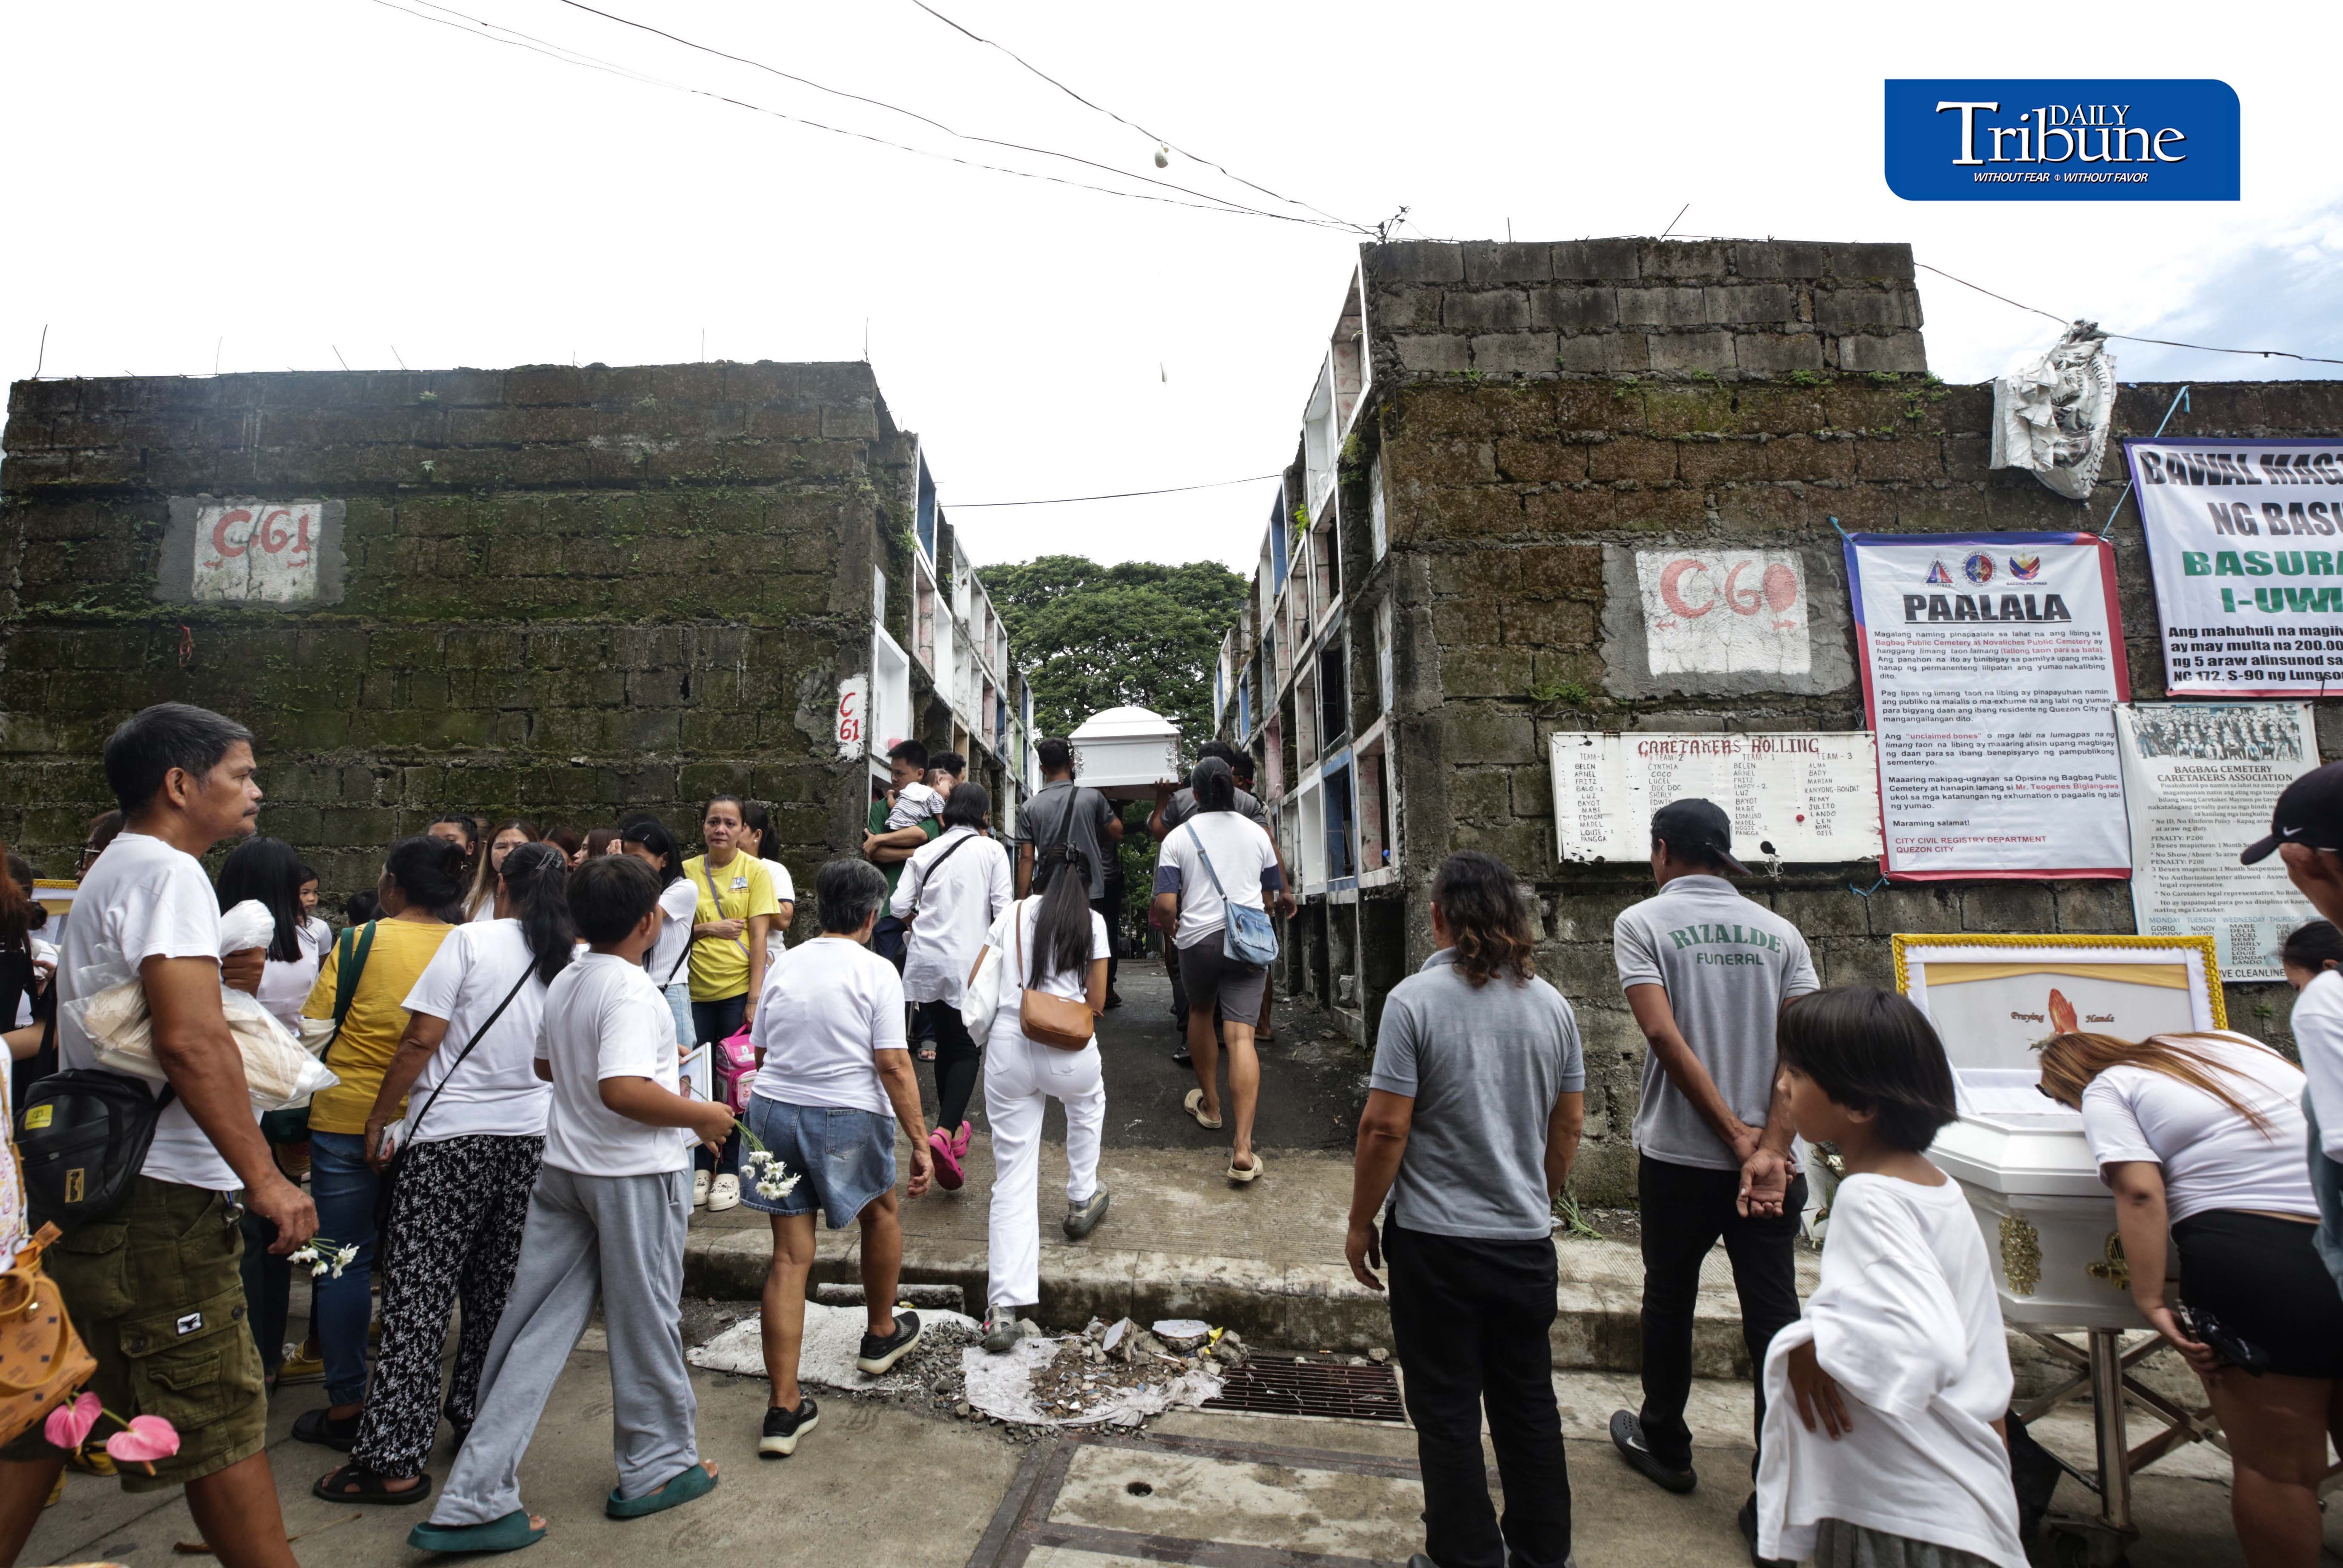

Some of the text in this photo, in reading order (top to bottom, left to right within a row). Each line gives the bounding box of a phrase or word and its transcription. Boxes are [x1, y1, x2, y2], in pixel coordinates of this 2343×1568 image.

[2140, 451, 2262, 486] BAWAL
[2207, 502, 2259, 536] NG
[2182, 551, 2343, 576] BASUR
[1903, 594, 2072, 620] PAALALA
[2169, 627, 2198, 638] Ang
[2202, 626, 2274, 636] mahuhuli
[2277, 627, 2295, 636] na
[2171, 643, 2187, 652] ay
[2191, 643, 2223, 652] may
[2227, 641, 2270, 651] multa
[2274, 642, 2291, 651] na
[2173, 658, 2190, 667] ng
[2194, 657, 2204, 666] 5
[2208, 657, 2247, 666] araw
[2251, 656, 2323, 665] alinsunod
[2228, 670, 2263, 680] S-90
[2268, 671, 2285, 680] ng
[2289, 670, 2343, 680] Lungso
[840, 692, 859, 742] C 61
[1638, 740, 1741, 755] CARETAKERS
[1668, 924, 1781, 953] RIZALDE
[1697, 953, 1764, 965] FUNERAL
[2011, 1011, 2114, 1022] Praying Hands
